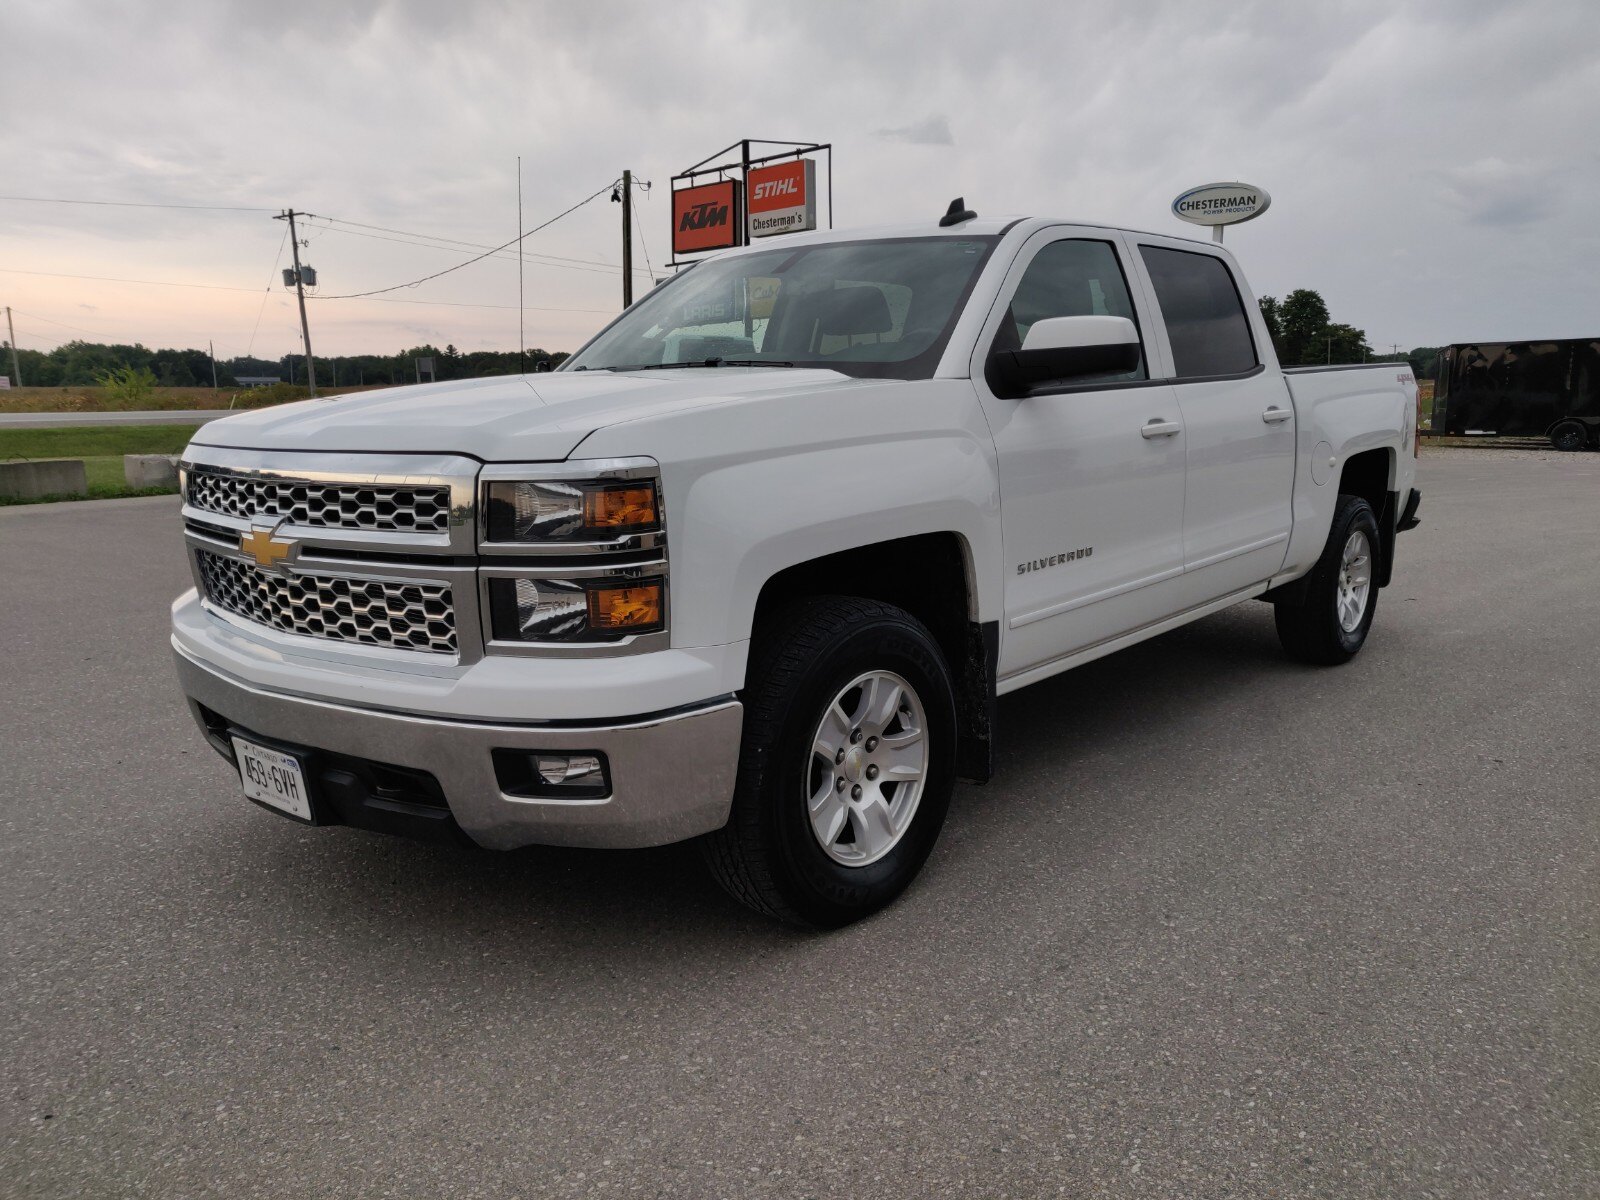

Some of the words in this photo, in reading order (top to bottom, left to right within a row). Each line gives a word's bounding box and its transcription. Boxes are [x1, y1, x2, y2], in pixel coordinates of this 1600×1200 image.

[753, 177, 798, 200] STIHL
[1179, 195, 1257, 212] CHESTERMAN
[679, 201, 728, 232] KTM
[752, 212, 803, 231] Chesterman's
[683, 303, 725, 320] LARIS
[1016, 546, 1093, 576] SILVERADO
